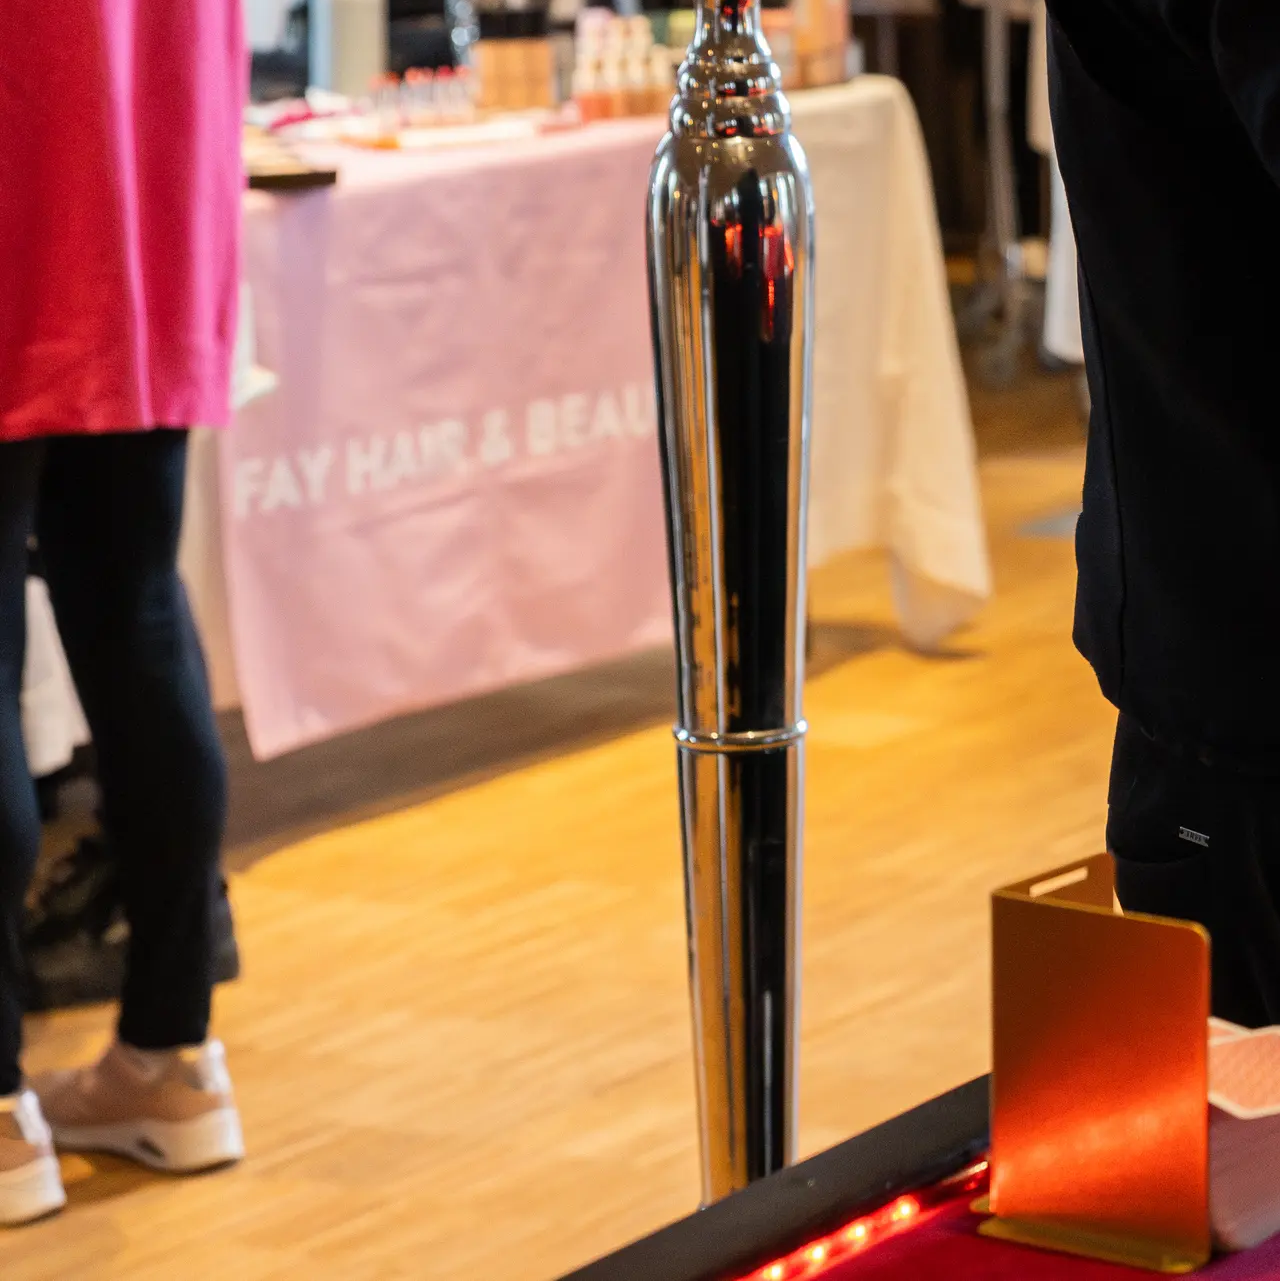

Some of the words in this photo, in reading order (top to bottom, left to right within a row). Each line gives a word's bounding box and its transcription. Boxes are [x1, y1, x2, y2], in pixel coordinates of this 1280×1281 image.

[233, 447, 332, 519] FAY
[347, 417, 469, 495] HAIR
[481, 408, 513, 464] &
